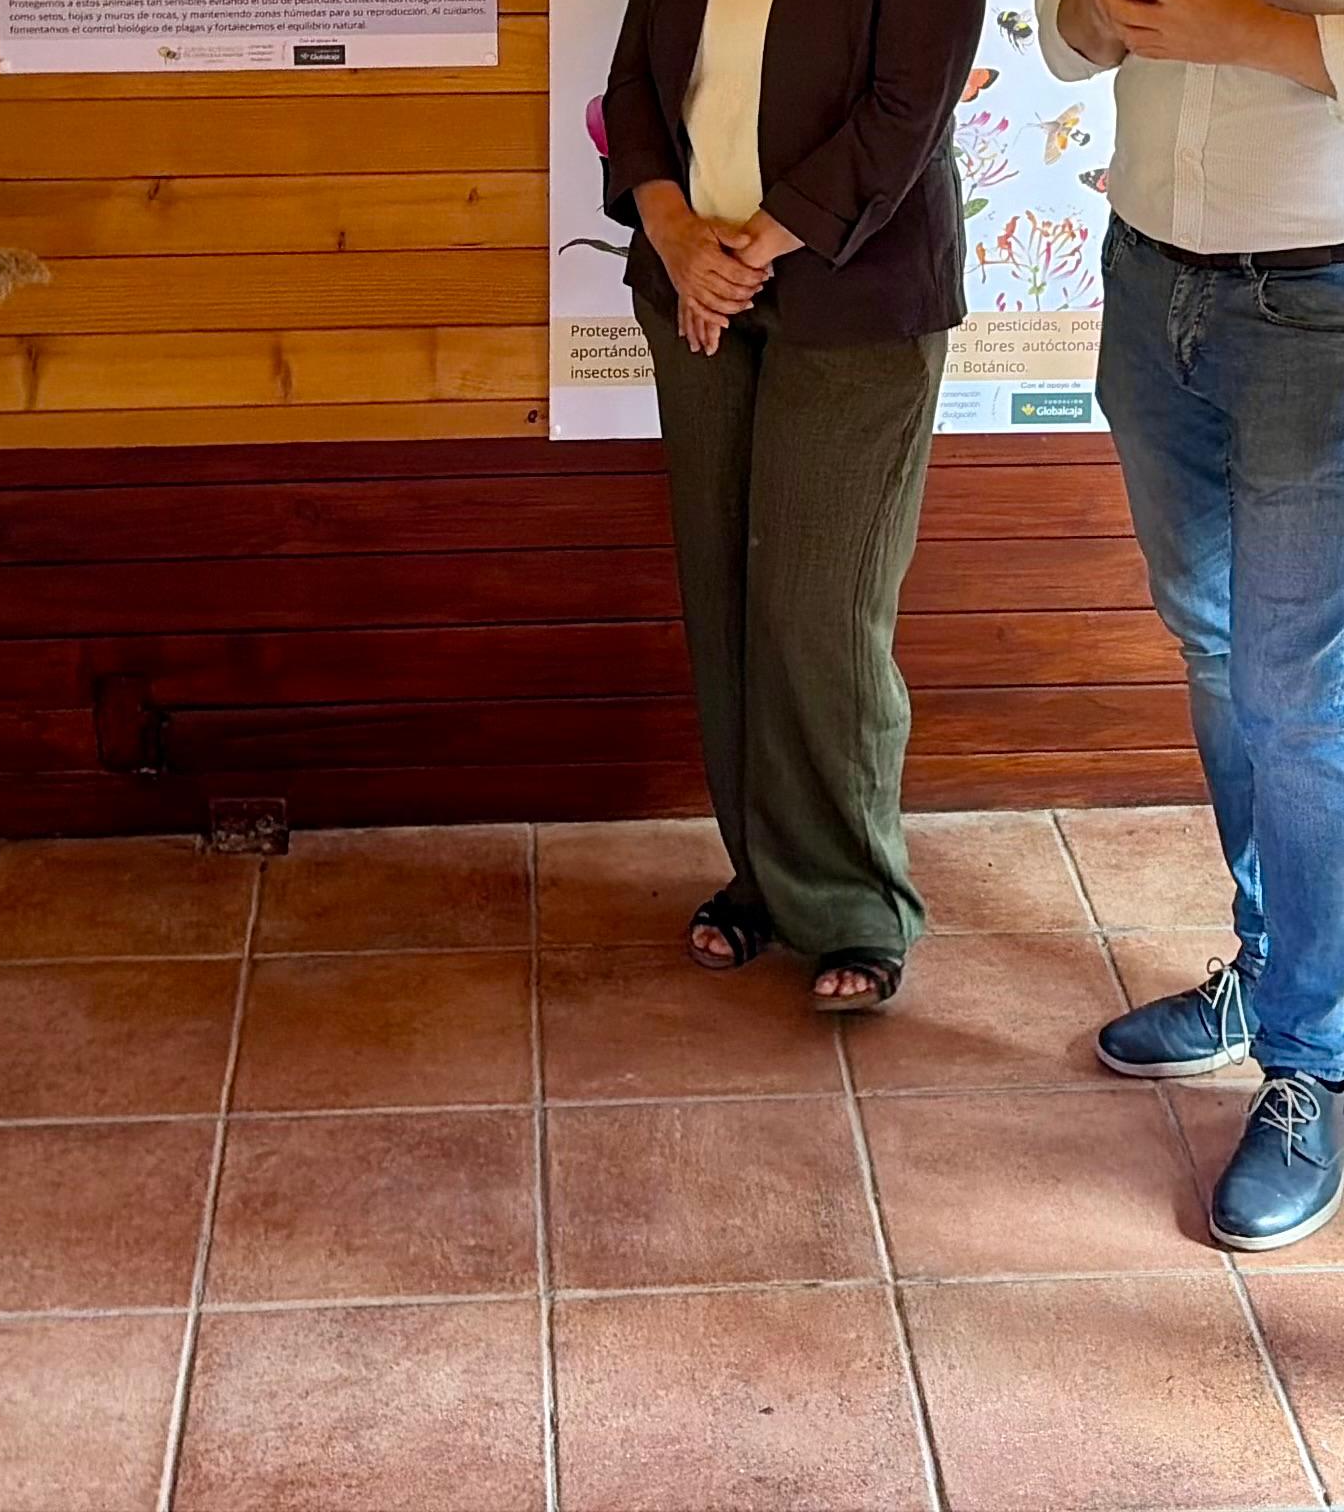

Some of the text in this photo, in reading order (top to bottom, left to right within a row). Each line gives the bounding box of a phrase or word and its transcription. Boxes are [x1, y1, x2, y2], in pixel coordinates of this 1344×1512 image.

[570, 322, 643, 341] Protegem
[986, 317, 1061, 336] pesticidas,
[973, 338, 1015, 353] flores
[570, 364, 630, 379] insectos
[962, 358, 1028, 373] Botánico.
[1035, 404, 1083, 418] Globalcaja
